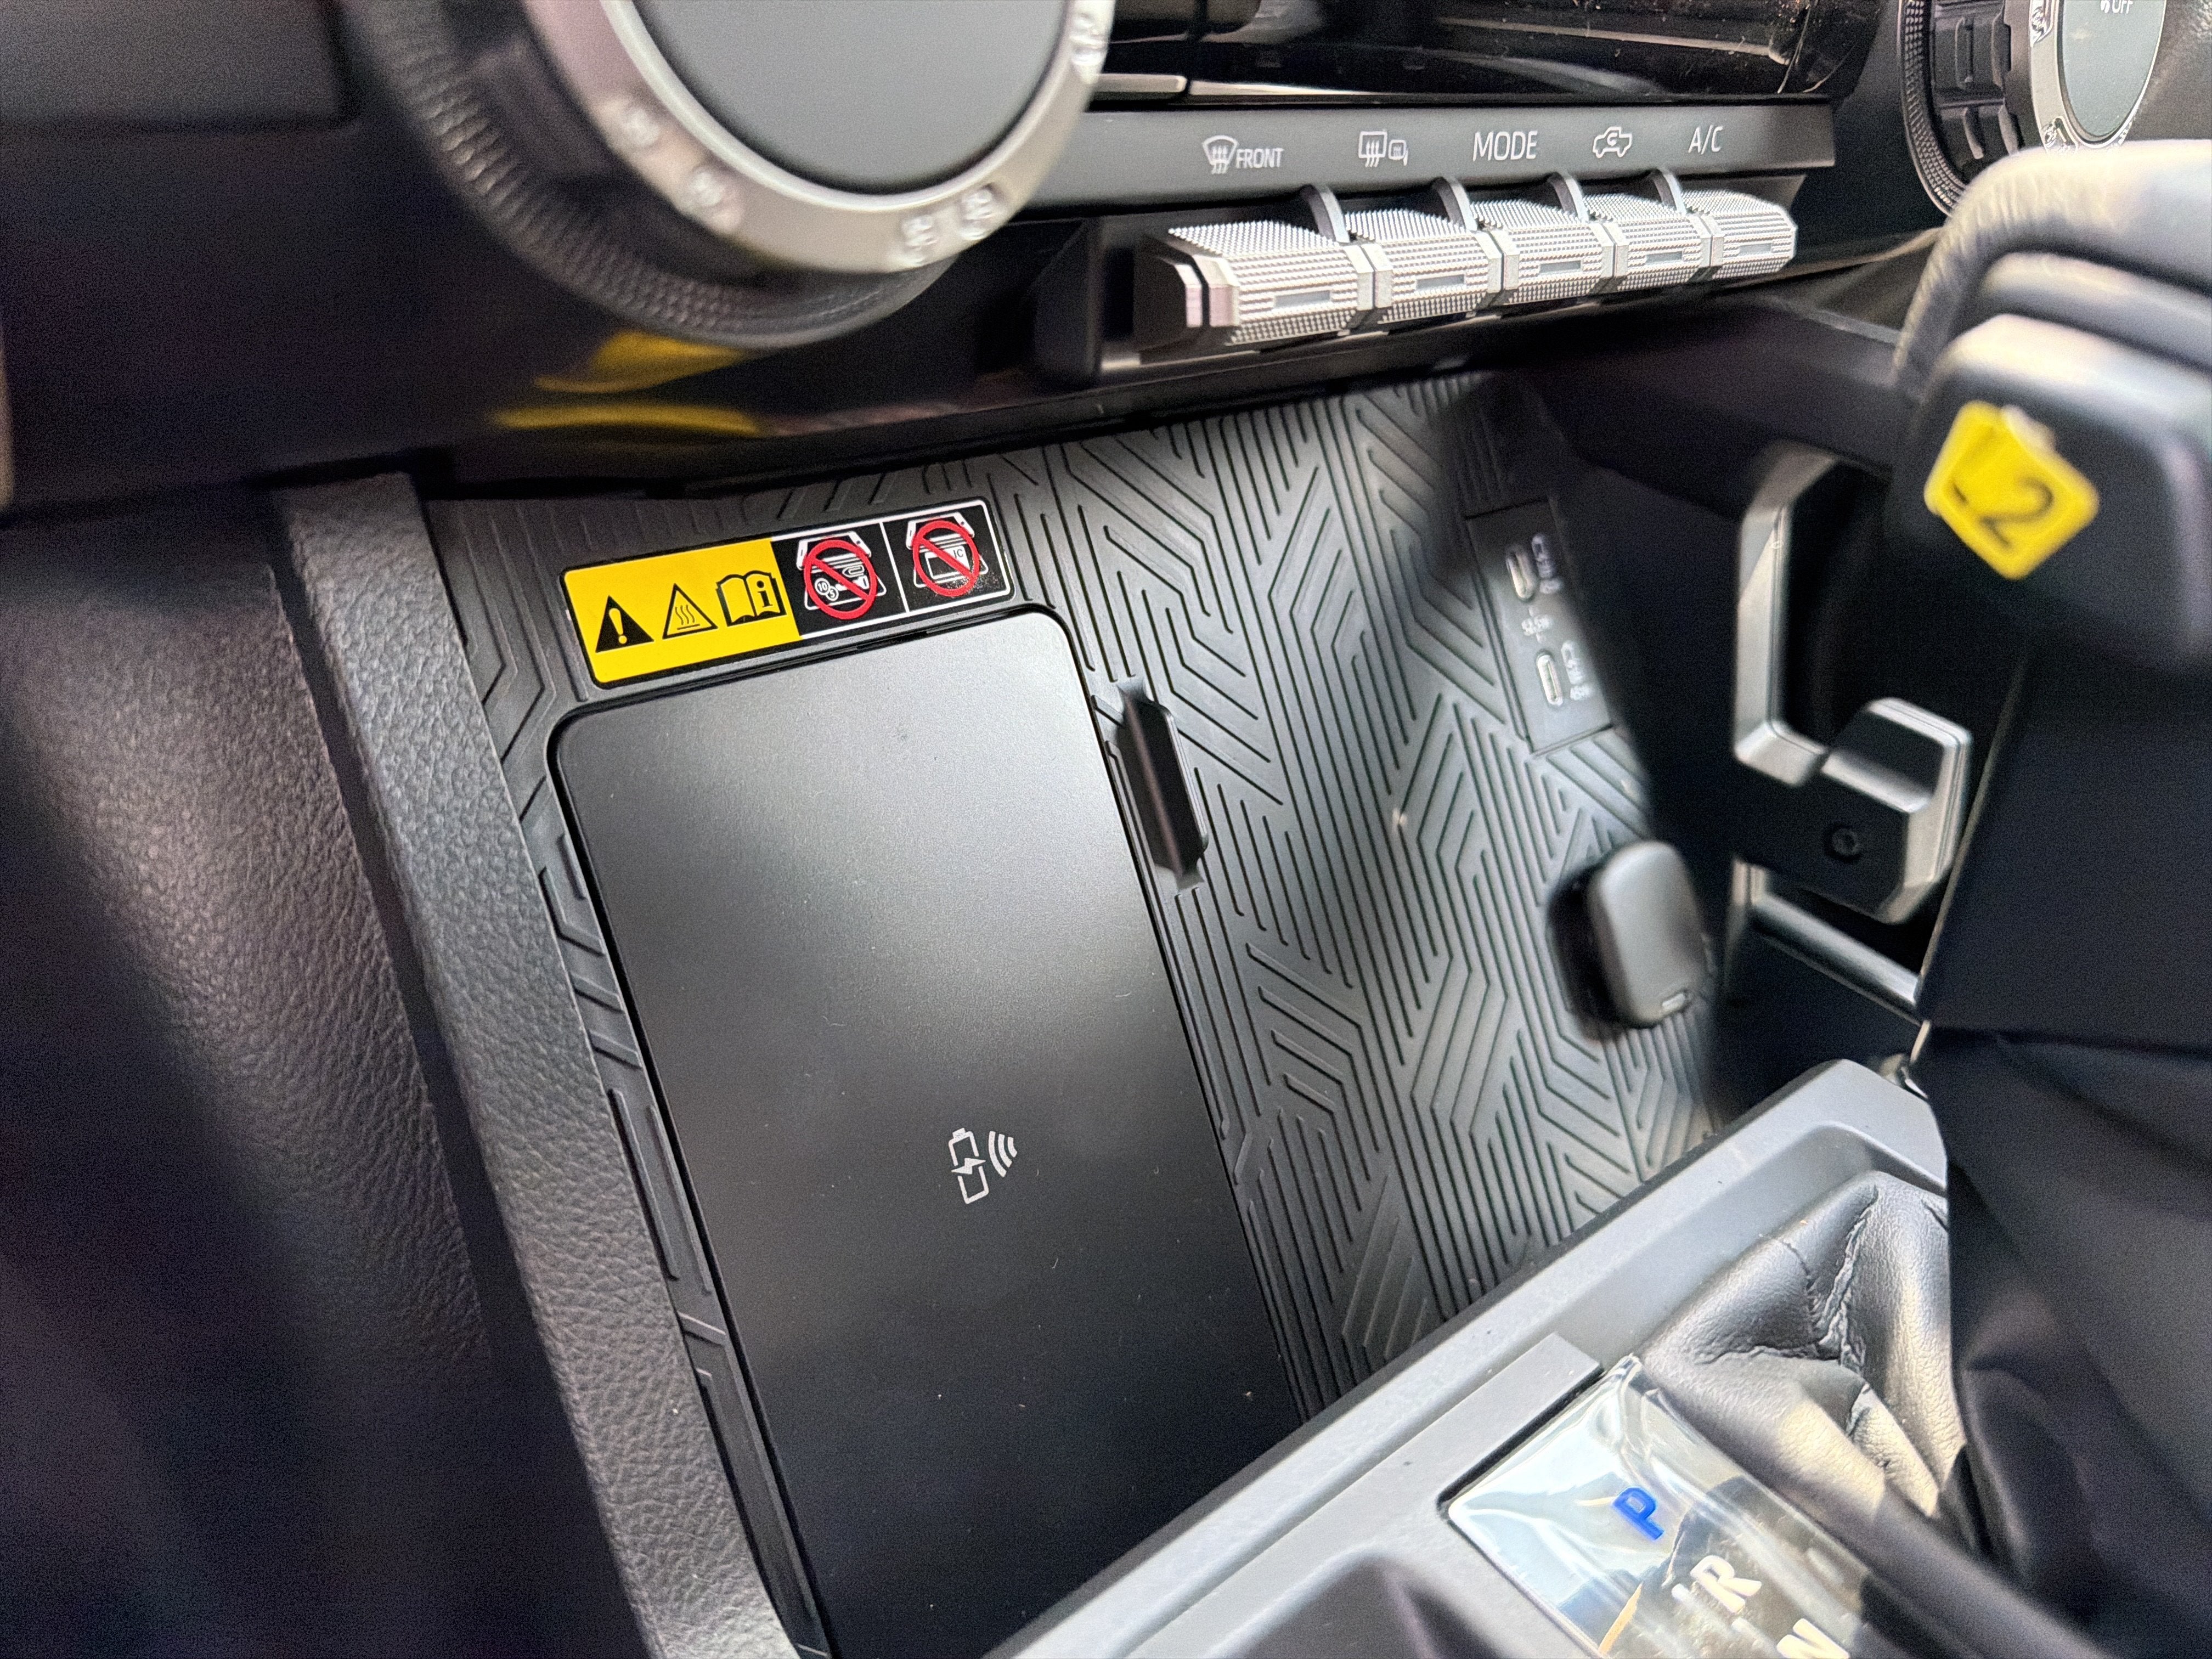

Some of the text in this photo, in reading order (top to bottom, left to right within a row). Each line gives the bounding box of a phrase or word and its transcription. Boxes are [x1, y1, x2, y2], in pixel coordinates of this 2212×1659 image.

[1472, 130, 1538, 162] MODE
[1688, 125, 1723, 155] A/C
[1235, 146, 1284, 169] FRONT
[953, 549, 963, 559] IC
[817, 582, 827, 592] 10
[1612, 1486, 1665, 1542] P
[1690, 1555, 1763, 1614] R
